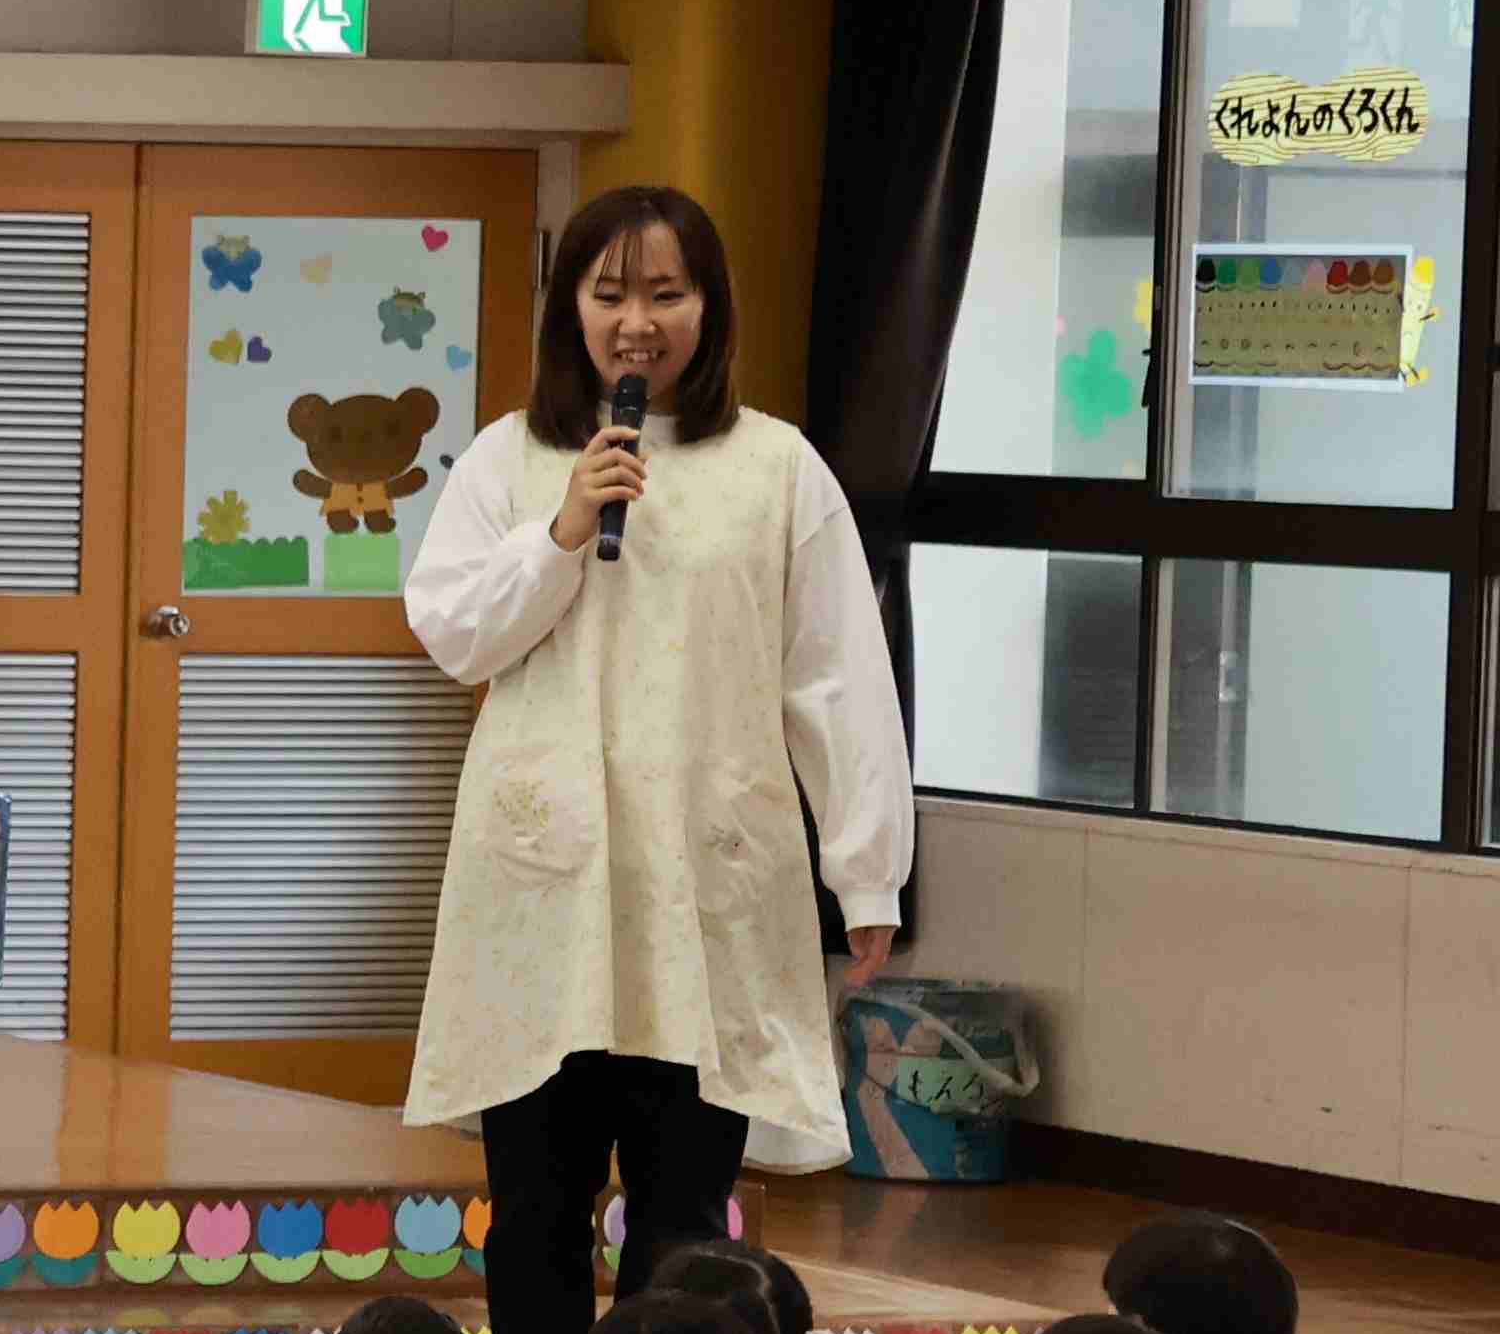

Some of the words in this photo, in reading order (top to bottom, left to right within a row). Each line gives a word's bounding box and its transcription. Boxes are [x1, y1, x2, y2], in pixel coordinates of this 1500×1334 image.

[1215, 87, 1420, 140] くれよんのくろくん
